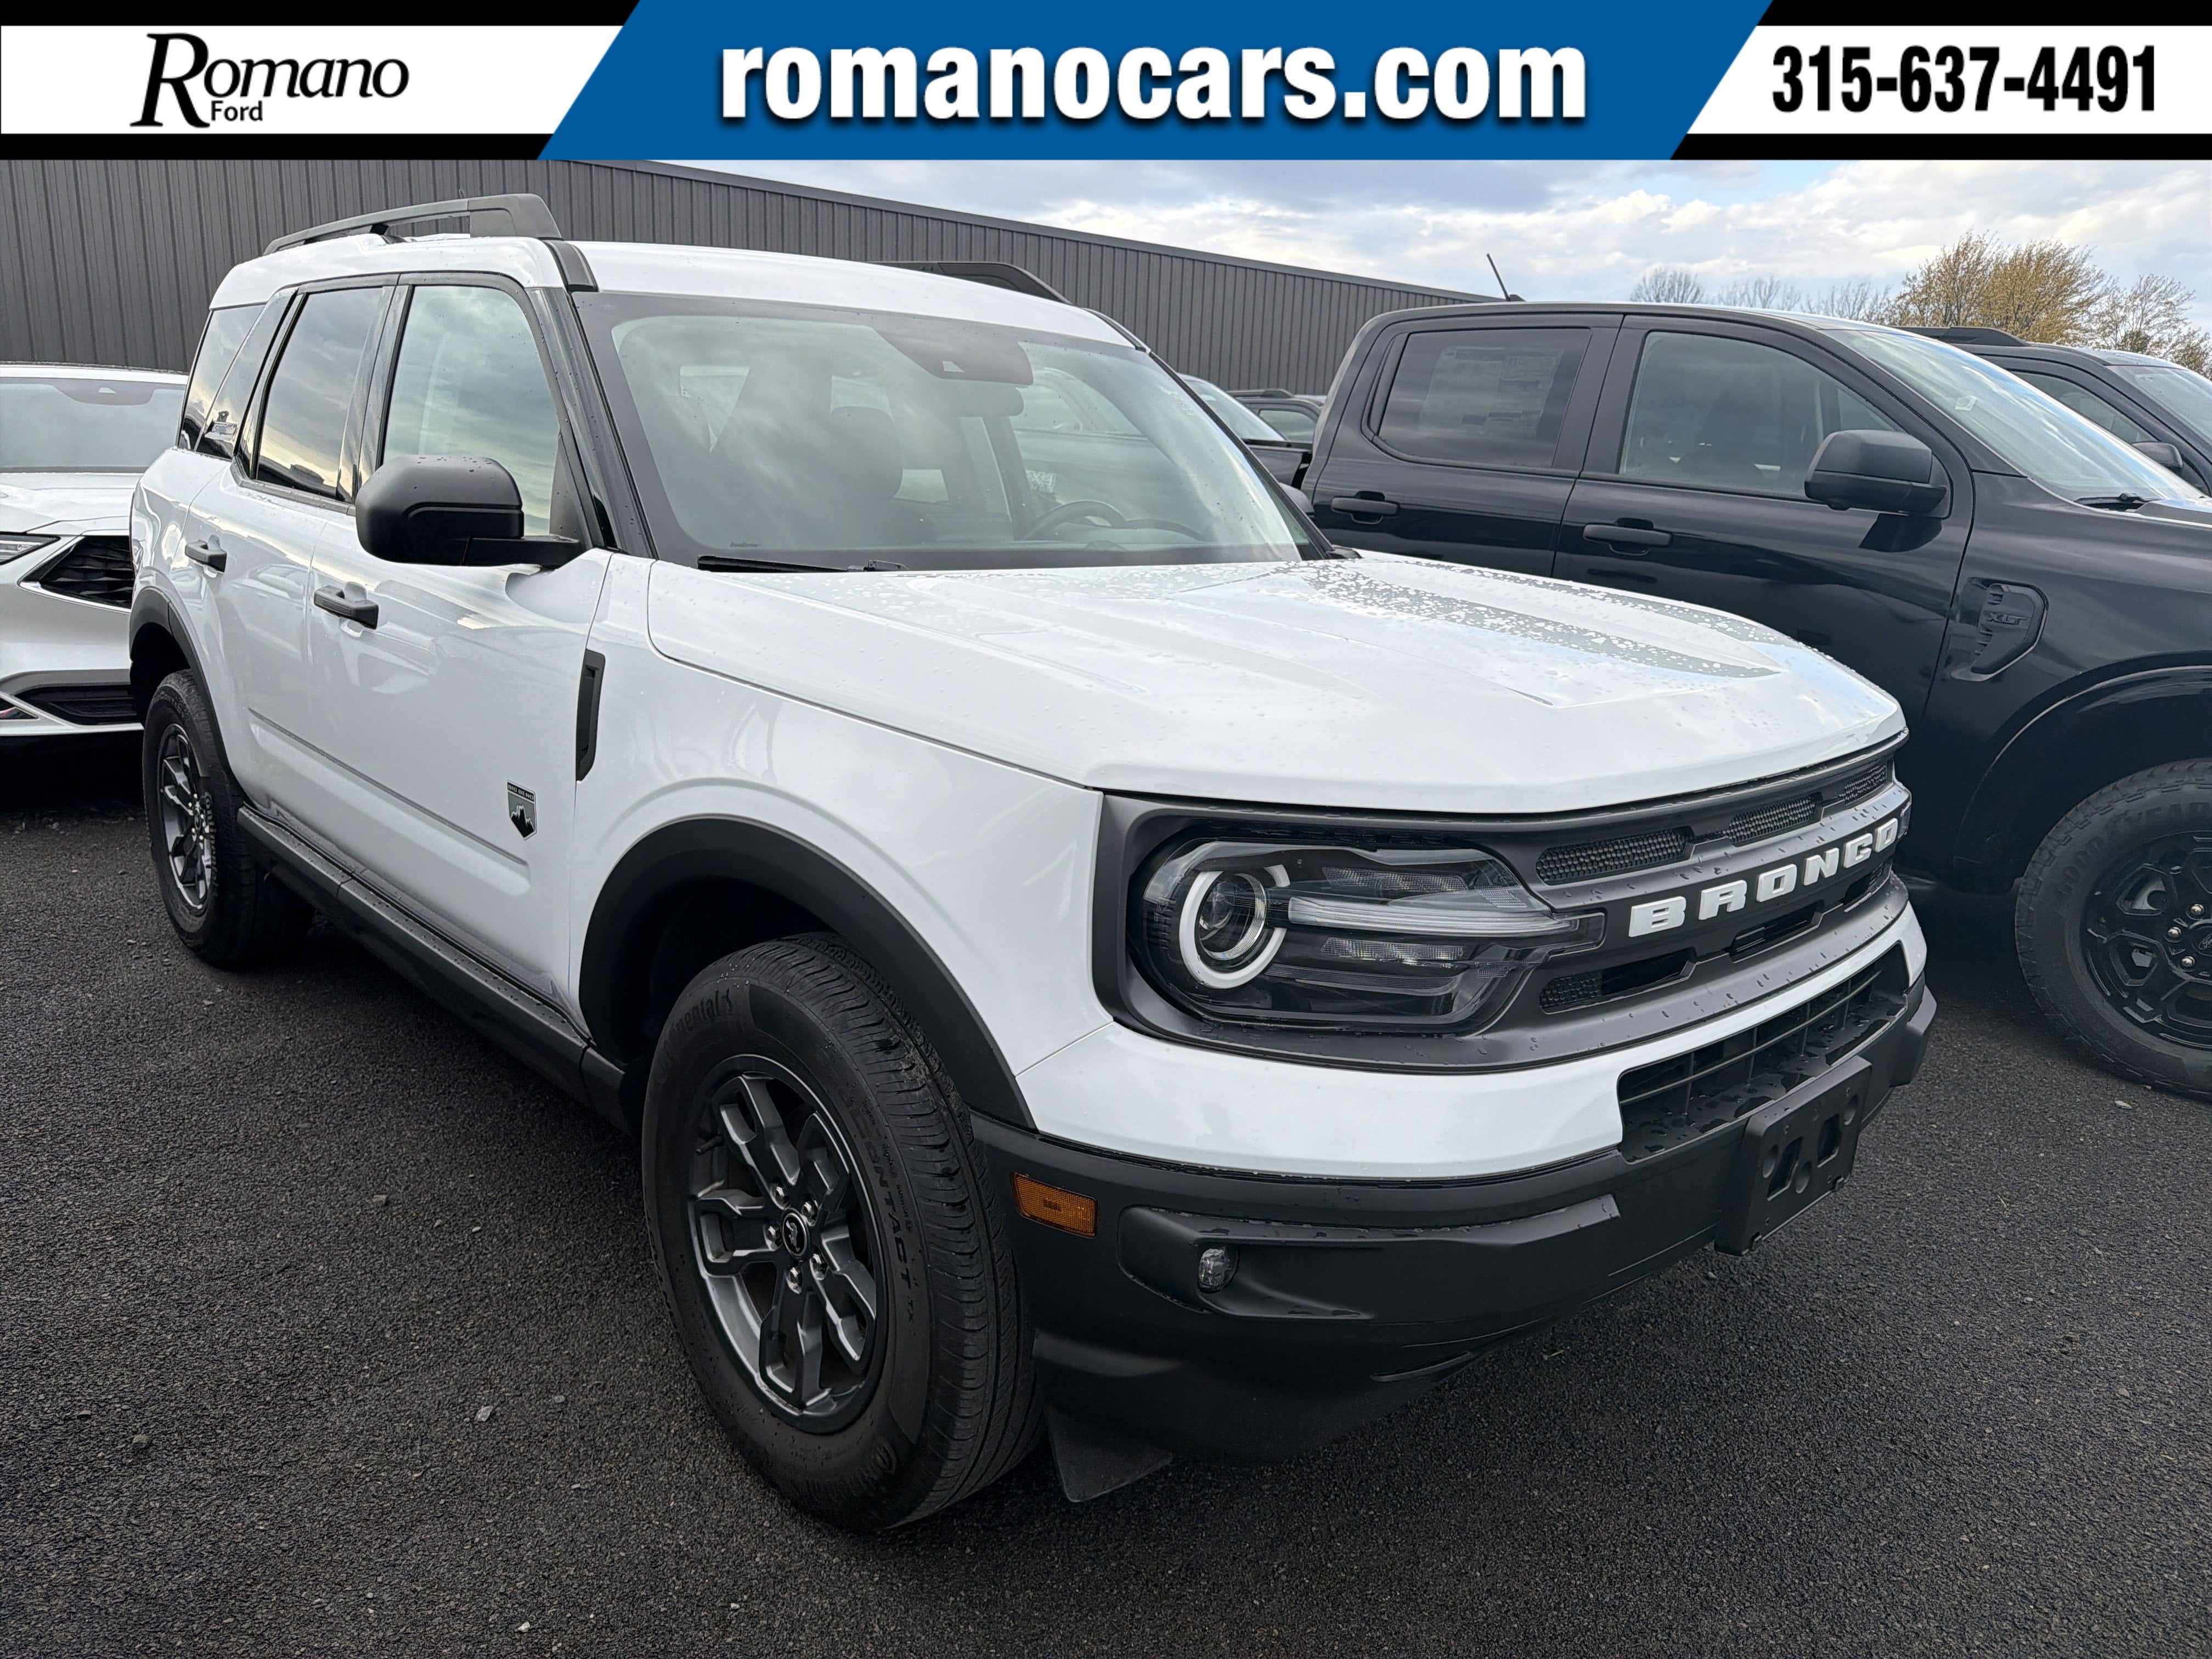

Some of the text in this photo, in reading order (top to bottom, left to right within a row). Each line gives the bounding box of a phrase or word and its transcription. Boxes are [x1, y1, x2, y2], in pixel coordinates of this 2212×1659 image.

[1984, 611, 2028, 625] XLT
[507, 783, 534, 801] BIG BEND
[1628, 818, 1899, 938] BRONCO
